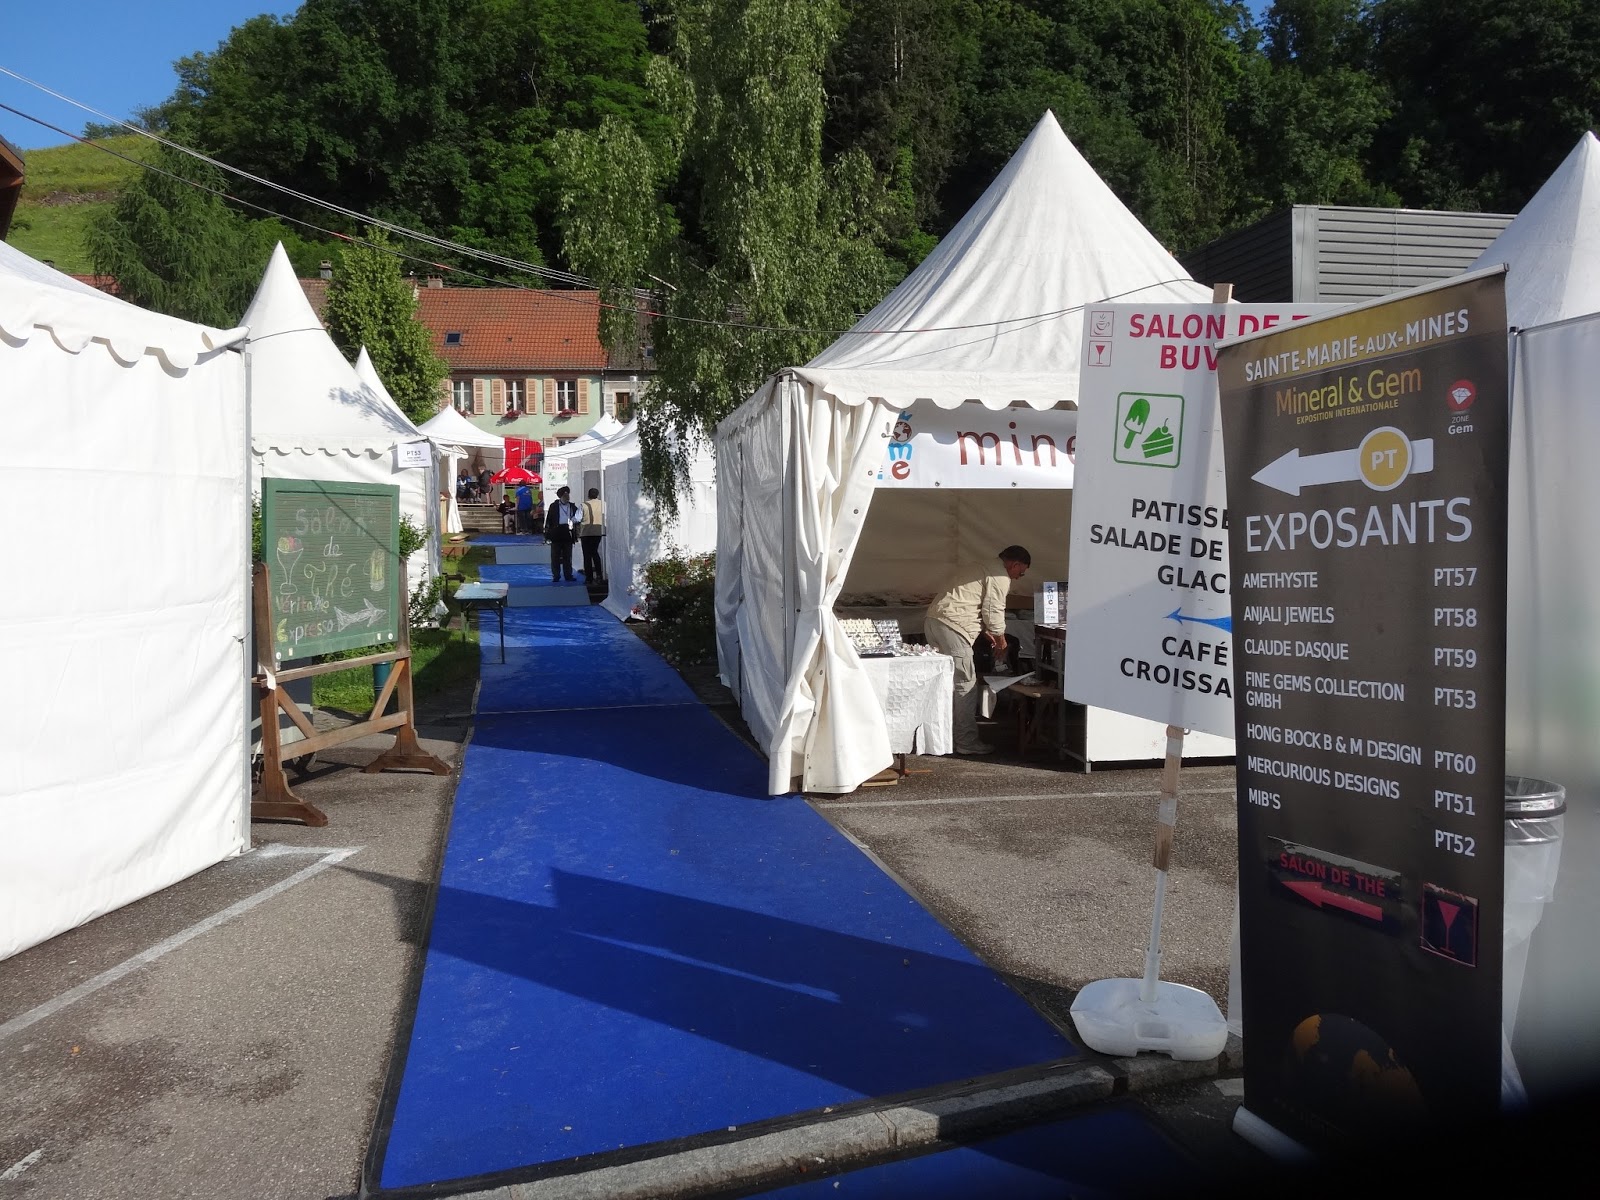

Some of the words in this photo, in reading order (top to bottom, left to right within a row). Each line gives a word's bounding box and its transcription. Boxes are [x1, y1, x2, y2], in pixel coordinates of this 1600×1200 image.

[1129, 313, 1226, 339] SALON
[1160, 344, 1218, 371] BUV
[1245, 308, 1469, 382] SAINTE-MARIE-AUX-MINES
[1275, 377, 1343, 417] Mineral
[1348, 377, 1363, 403] &
[1367, 368, 1422, 400] Gem
[1296, 411, 1334, 425] EXPOSITION
[1335, 399, 1399, 417] INTERNATIONALE
[1451, 415, 1469, 424] ZONE
[1448, 423, 1473, 435] Gem
[1371, 449, 1397, 470] PT
[1246, 497, 1472, 552] EXPOSANTS
[323, 536, 343, 557] de
[1090, 524, 1181, 555] SALADE
[1190, 537, 1223, 561] DE
[303, 561, 357, 597] Thé
[1157, 565, 1230, 594] GLAC
[1243, 571, 1318, 589] AMETHYSTE
[1434, 567, 1477, 587] PT57
[1243, 606, 1281, 625] ANJALI
[1284, 606, 1335, 625] JEWELS
[1434, 608, 1477, 627] PT58
[1162, 636, 1228, 666] CAFÉ
[1244, 638, 1291, 657] CLAUDE
[1295, 641, 1349, 662] DASQUE
[1434, 648, 1477, 668] PT59
[1120, 657, 1232, 699] CROISSA
[1245, 671, 1270, 689] FINE
[1273, 674, 1311, 692] GEMS
[1314, 677, 1405, 702] COLLECTION
[1434, 687, 1477, 709] PT53
[1246, 691, 1282, 709] GMBH
[1247, 723, 1281, 743] HONG
[1284, 728, 1321, 750] BOCK
[1323, 734, 1332, 750] B
[1335, 736, 1347, 754] &
[1350, 738, 1362, 756] M
[1367, 740, 1421, 766] DESIGN
[1434, 750, 1476, 775] PT60
[1247, 755, 1330, 786] MERCURIOUS
[1335, 771, 1400, 800] DESIGNS
[1434, 790, 1476, 816] PT51
[1248, 788, 1281, 810] MIB'S
[1434, 829, 1475, 857] PT52
[1280, 852, 1326, 880] SALON
[1331, 868, 1350, 888] DE
